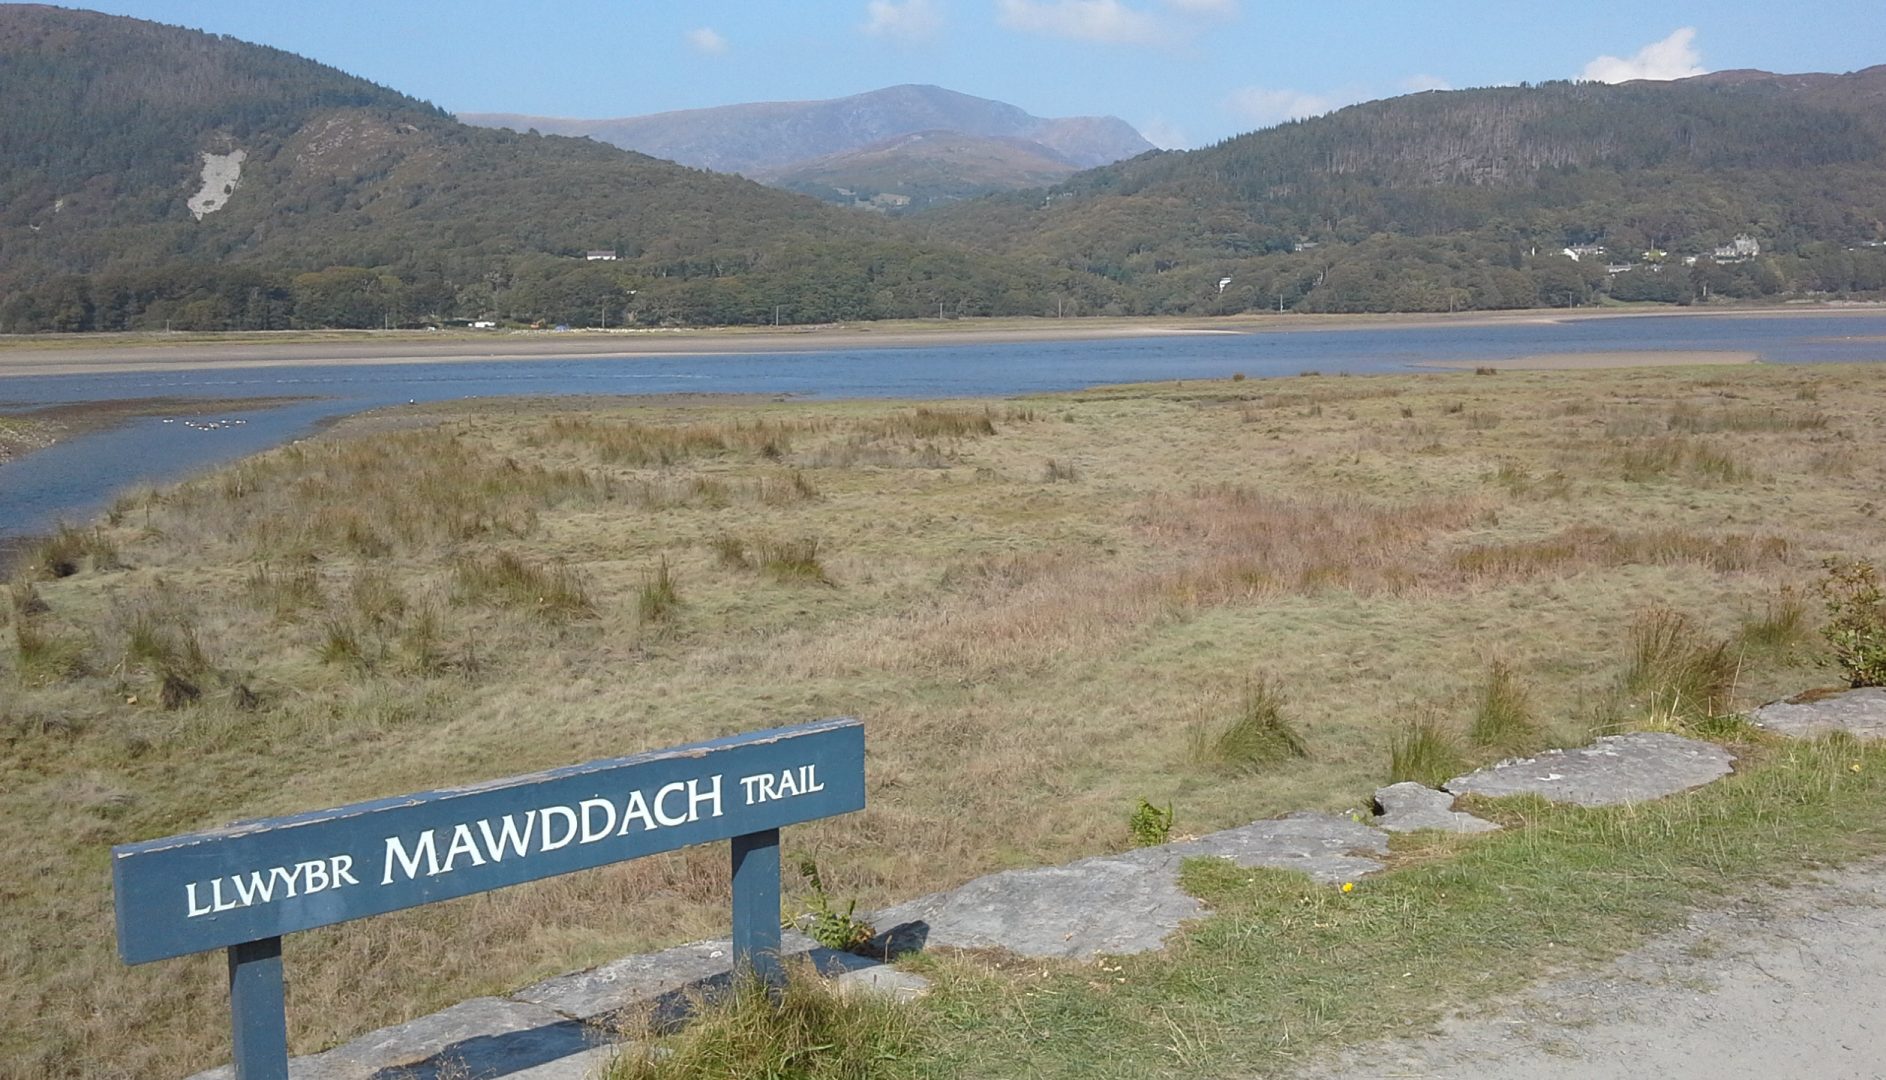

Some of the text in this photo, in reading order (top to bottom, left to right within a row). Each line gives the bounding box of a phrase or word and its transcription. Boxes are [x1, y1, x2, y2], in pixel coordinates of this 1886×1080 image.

[185, 764, 825, 918] LLWYBR MAWDDACH TRAIL
